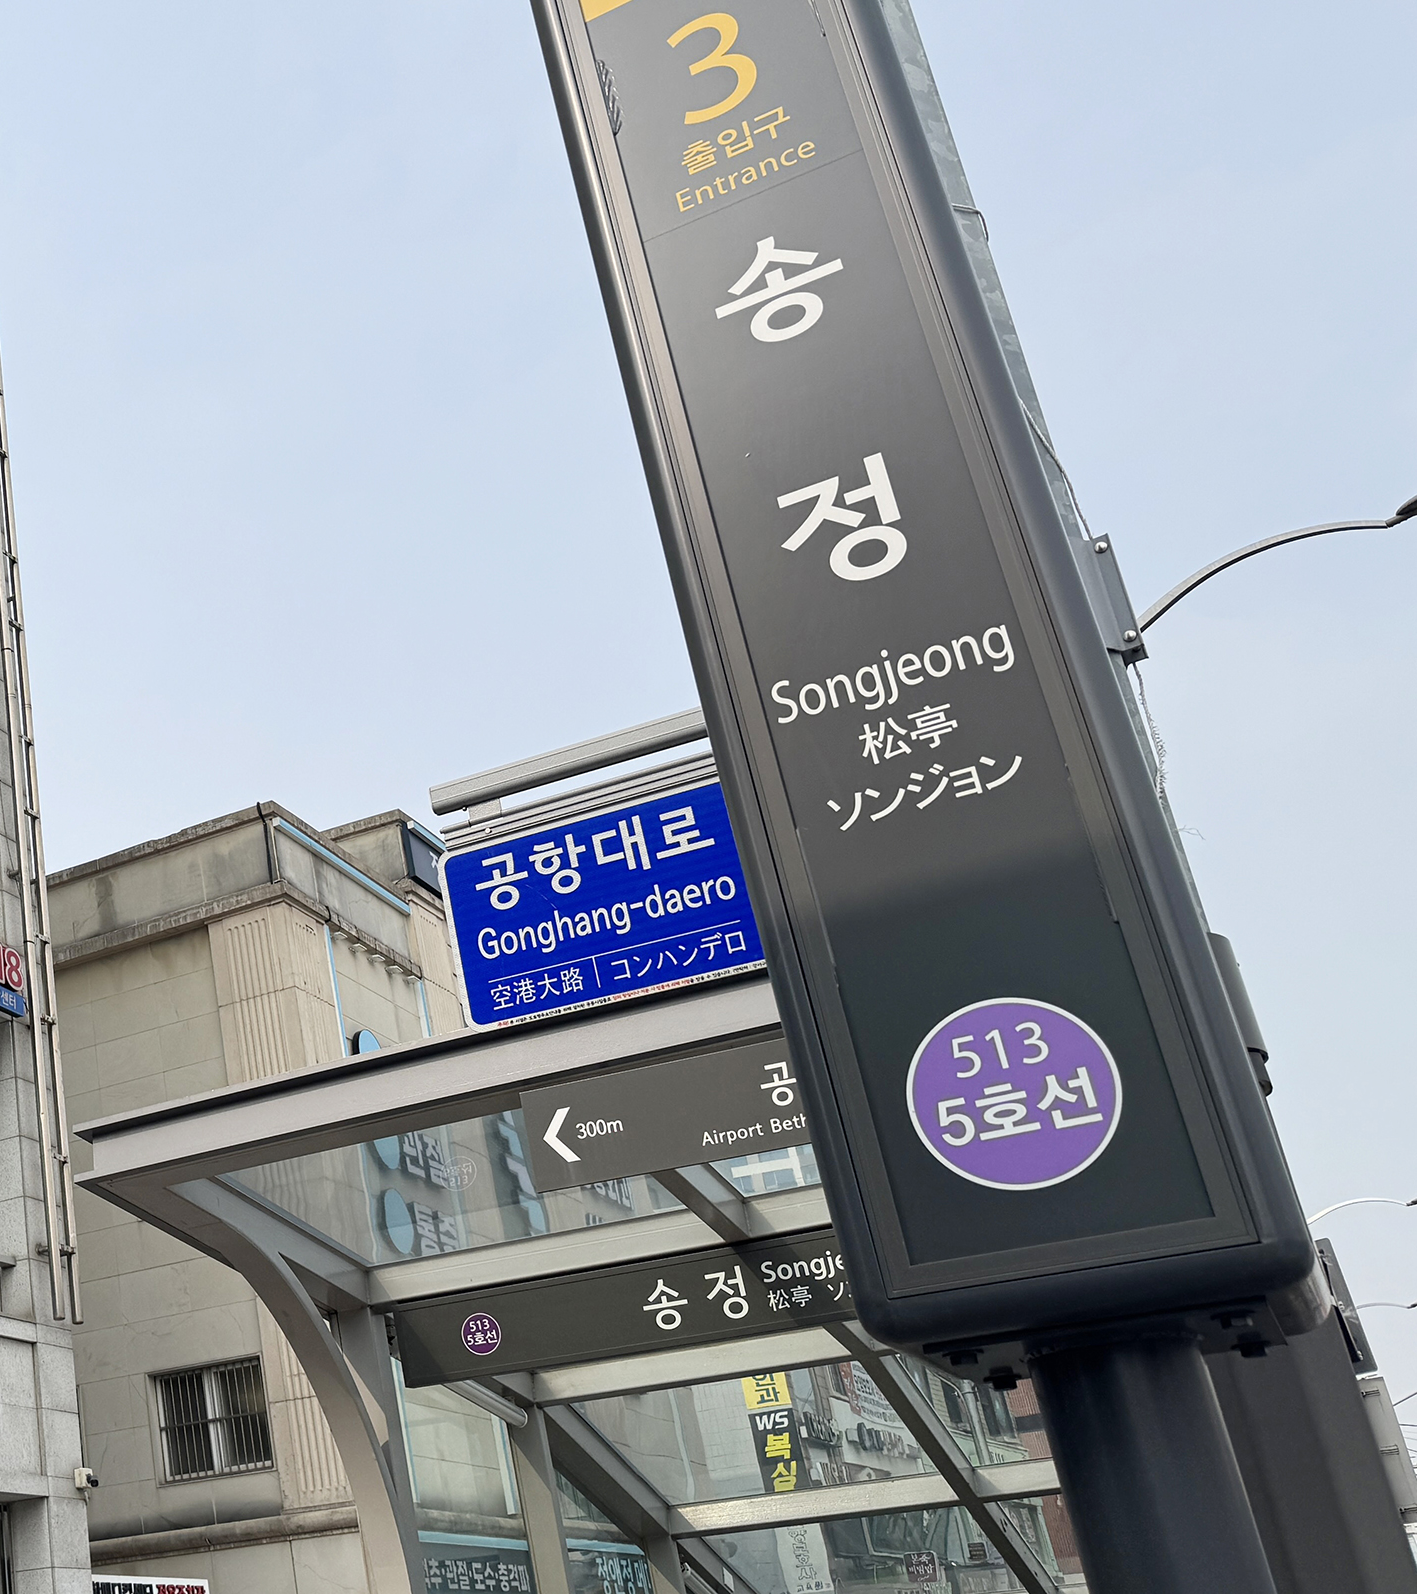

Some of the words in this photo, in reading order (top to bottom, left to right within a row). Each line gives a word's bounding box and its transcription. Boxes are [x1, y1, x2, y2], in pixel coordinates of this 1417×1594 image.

[666, 12, 757, 125] 3
[675, 138, 816, 212] Entrance
[681, 106, 790, 175] 출입구
[771, 624, 1015, 725] Songjeong
[858, 702, 959, 765] 松亭
[826, 754, 1023, 832] ソンジョン
[475, 806, 716, 911] 공항대로
[477, 875, 737, 960] Gonghang-daero
[490, 967, 584, 1012] 空港大路
[610, 931, 747, 982] コンハンデロ
[951, 1022, 1050, 1079] 513
[575, 1119, 624, 1140] 300m
[702, 1122, 764, 1147] Airport
[937, 1066, 1104, 1148] 5호선
[469, 1318, 490, 1332] 513
[768, 1284, 813, 1312] 松亭
[467, 1329, 498, 1346] 5호선
[755, 1411, 790, 1431] WS
